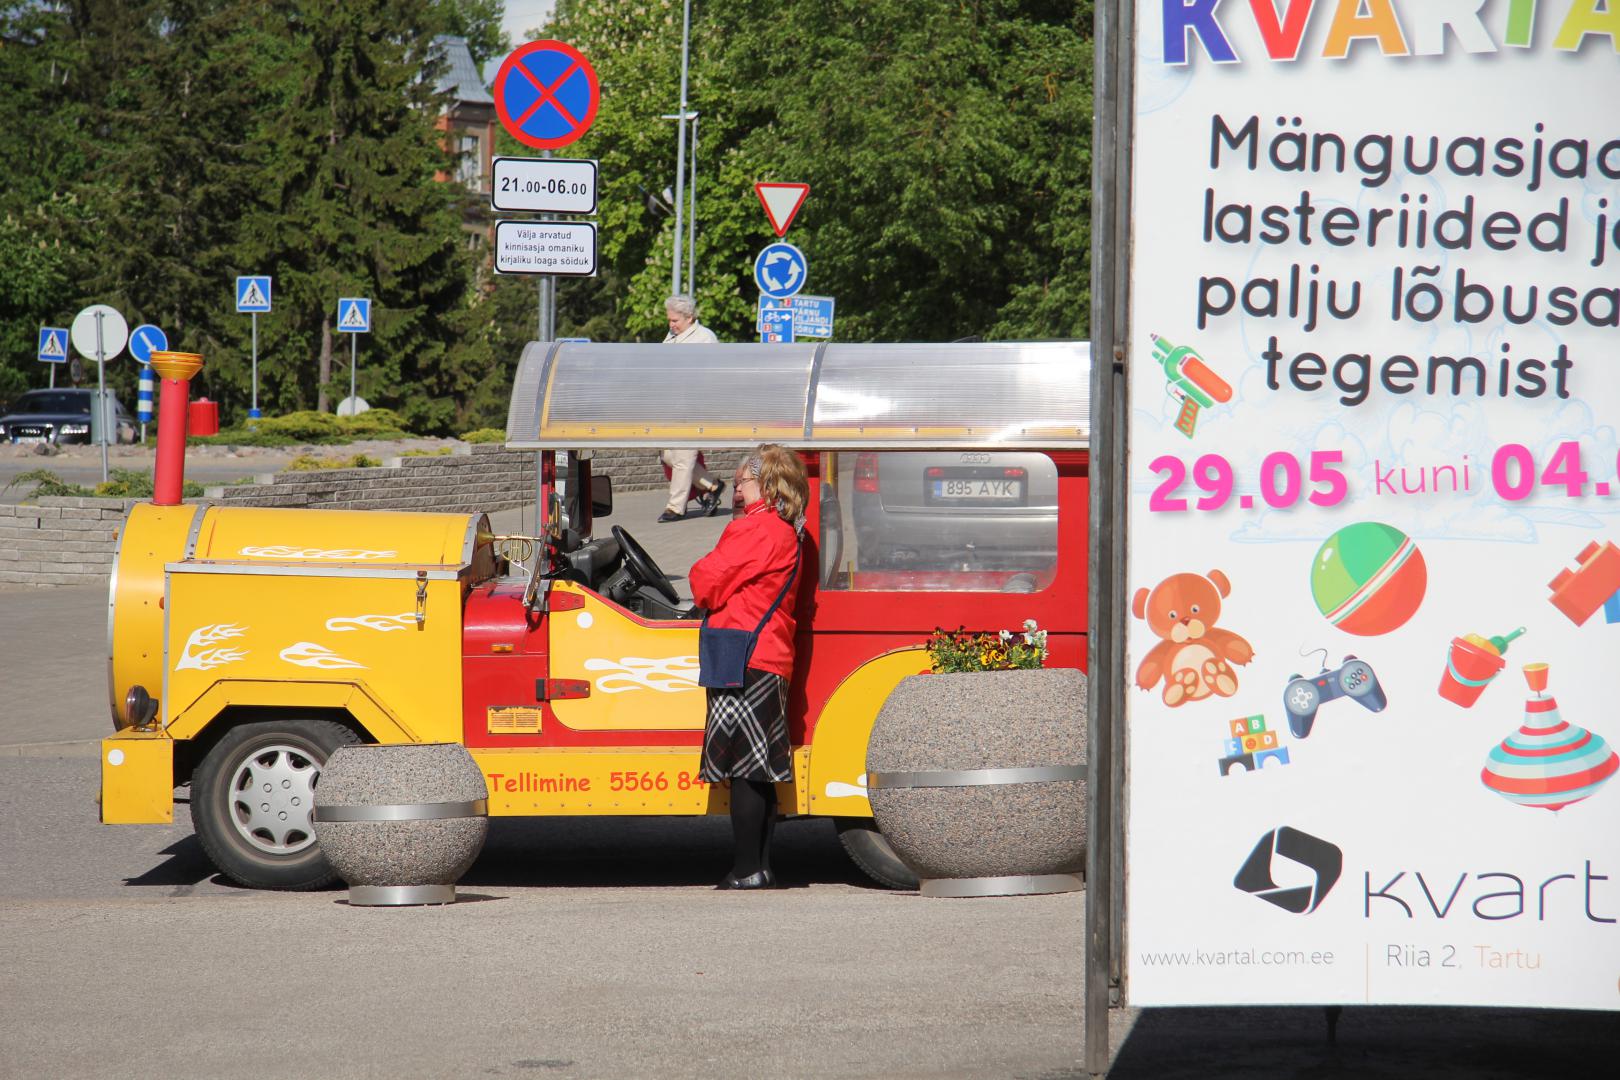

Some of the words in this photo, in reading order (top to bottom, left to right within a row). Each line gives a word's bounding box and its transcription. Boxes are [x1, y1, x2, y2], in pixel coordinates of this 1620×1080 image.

[502, 177, 587, 195] 21.00-06.00
[517, 230, 536, 241] Välja
[539, 231, 572, 240] arvatud
[1203, 187, 1569, 252] lasteriided
[1590, 197, 1620, 268] j
[505, 242, 545, 254] kinnisasja
[548, 243, 585, 253] omaniku
[500, 255, 532, 266] kirjaliku
[534, 256, 558, 267] loaga
[560, 256, 589, 266] sõiduk
[1197, 263, 1362, 333] palju
[1391, 264, 1620, 327] lõbusa
[1261, 335, 1574, 407] tegemist
[1148, 450, 1348, 512] 29.05
[1375, 455, 1469, 495] kuni
[1491, 441, 1620, 502] 04.
[946, 481, 973, 496] 895
[979, 481, 1014, 496] AYK
[488, 773, 591, 793] Tellimine
[610, 771, 669, 792] 5566
[1365, 860, 1617, 923] kvart
[1141, 947, 1335, 967] www.kvartal.com.ee
[1386, 944, 1431, 967] Riia
[1474, 945, 1541, 969] Tartu
